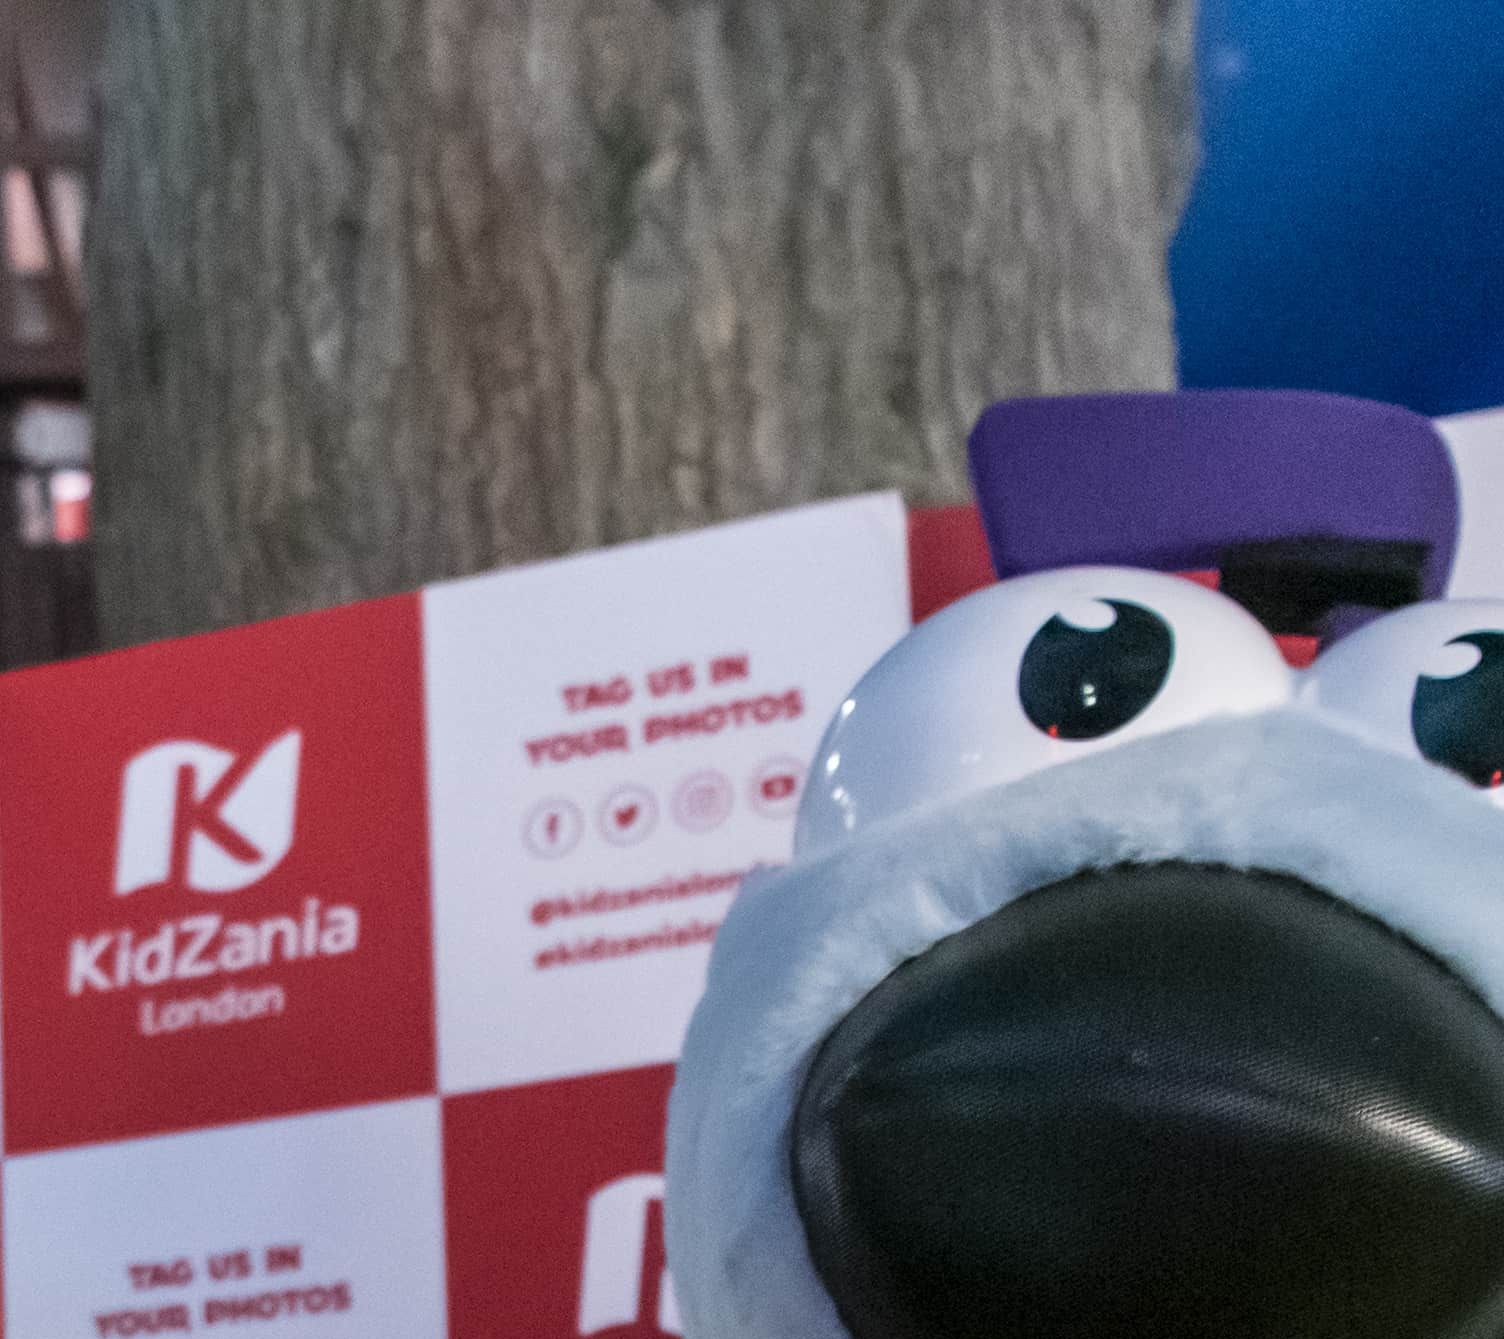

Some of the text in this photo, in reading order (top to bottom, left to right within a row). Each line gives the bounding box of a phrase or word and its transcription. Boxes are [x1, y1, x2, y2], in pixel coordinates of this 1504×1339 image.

[563, 656, 749, 712] TAG US IN
[524, 690, 804, 767] YOUR PHOTOS
[68, 896, 360, 996] KidZania
[141, 986, 284, 1037] London
[128, 1245, 302, 1291] TAG US IN
[95, 1282, 352, 1339] YOUR PHOTOS
